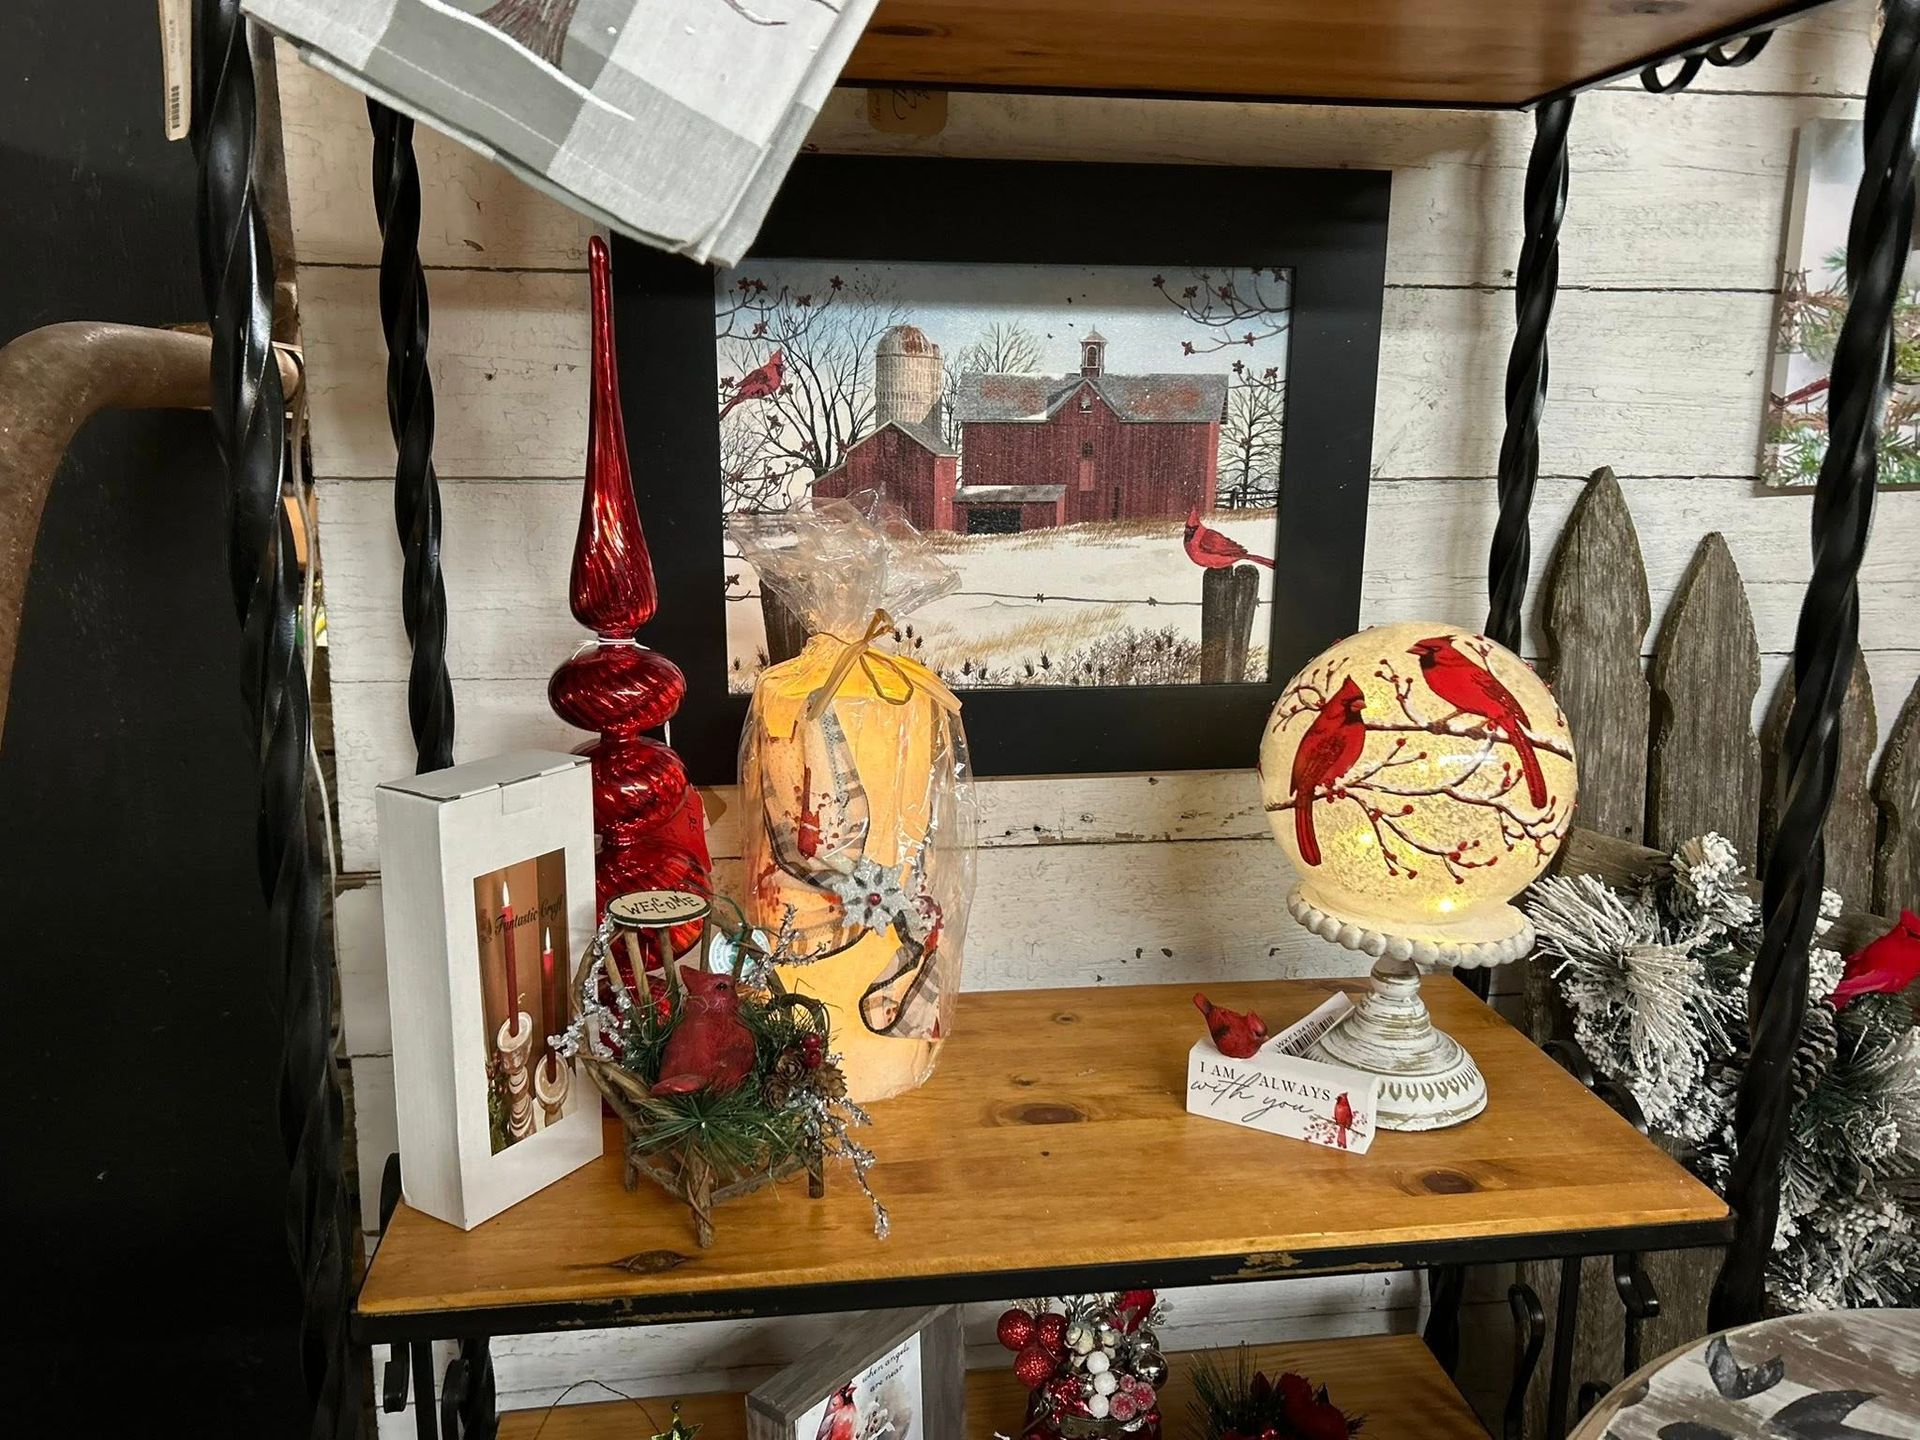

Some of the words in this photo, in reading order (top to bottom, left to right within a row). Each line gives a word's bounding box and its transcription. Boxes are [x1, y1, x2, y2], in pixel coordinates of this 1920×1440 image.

[621, 895, 700, 915] WELCOME
[1190, 1072, 1262, 1106] with
[1241, 1096, 1314, 1123] you
[1200, 1061, 1205, 1073] I
[1211, 1064, 1235, 1080] AM
[1259, 1075, 1331, 1101] ALWAYS
